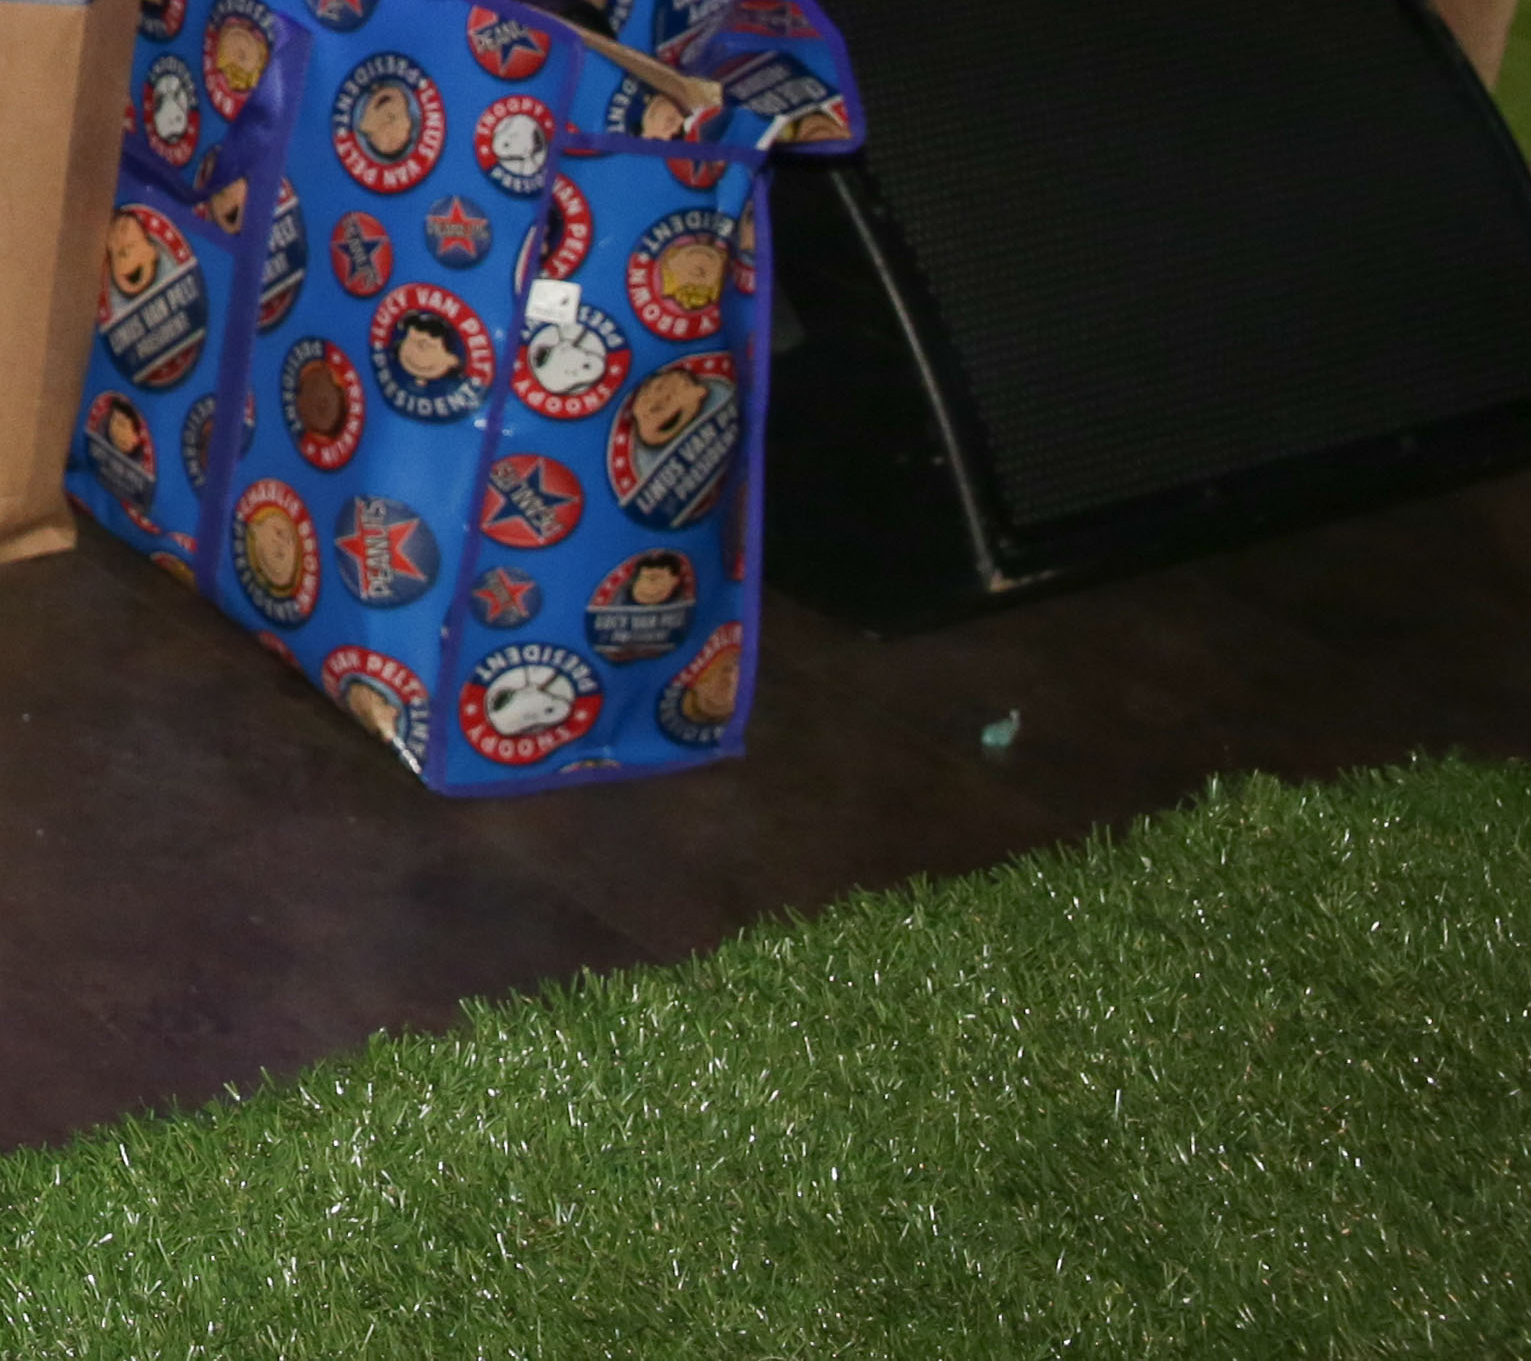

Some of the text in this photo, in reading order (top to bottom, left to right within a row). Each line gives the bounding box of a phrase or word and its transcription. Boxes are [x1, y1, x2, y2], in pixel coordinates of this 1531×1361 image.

[417, 86, 445, 160] LINUS
[383, 158, 424, 189] VAN
[374, 285, 493, 377] LUCY VAN PELT
[371, 351, 483, 417] PRESIDENT
[635, 456, 687, 515] LINUS
[677, 421, 718, 463] VAN
[362, 496, 394, 599] PEANUTS
[474, 643, 599, 695] PRESIDENT
[468, 724, 573, 761] SNOOPY
